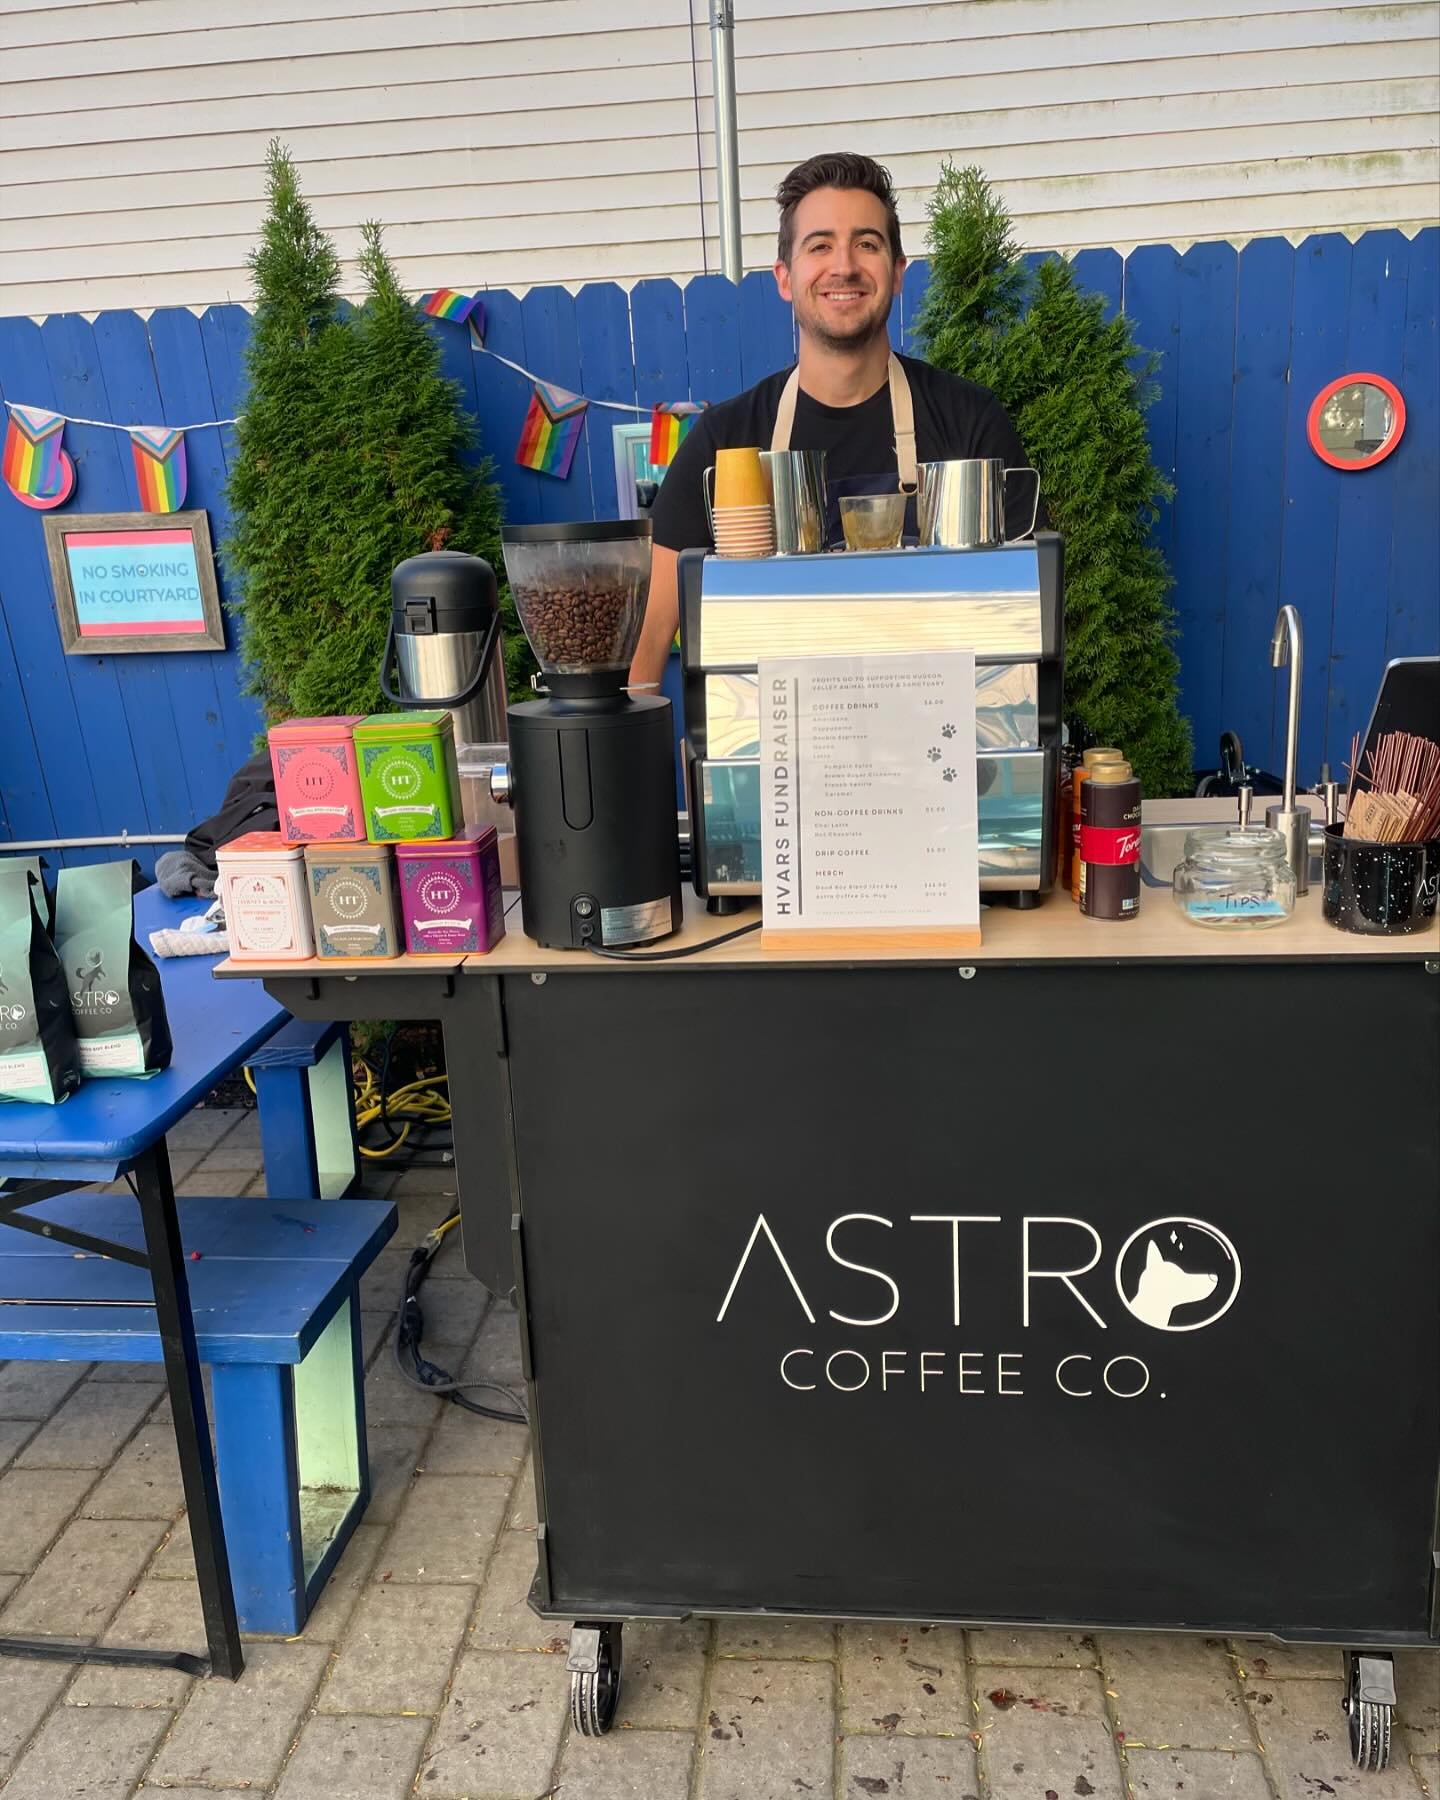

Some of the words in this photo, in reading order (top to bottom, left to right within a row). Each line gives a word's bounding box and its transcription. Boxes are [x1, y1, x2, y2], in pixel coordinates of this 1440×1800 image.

[82, 566, 107, 579] NO
[111, 563, 189, 578] SMOKING
[79, 591, 96, 604] IN
[100, 587, 200, 603] COURTYARD
[812, 703, 845, 712] COFFEE
[847, 701, 879, 711] DRINKS
[772, 678, 789, 827] FUNDRAISER
[391, 775, 412, 786] HT
[871, 806, 904, 816] DRINKS
[815, 849, 835, 857] DRIP
[837, 848, 870, 857] COFFEE
[776, 838, 791, 915] HVARS
[815, 869, 845, 877] MERCH
[339, 895, 359, 905] HT
[430, 889, 452, 901] HT
[716, 1212, 1242, 1332] ASTRO
[780, 1348, 1024, 1395] COFFEE
[1056, 1354, 1167, 1399] CO.
